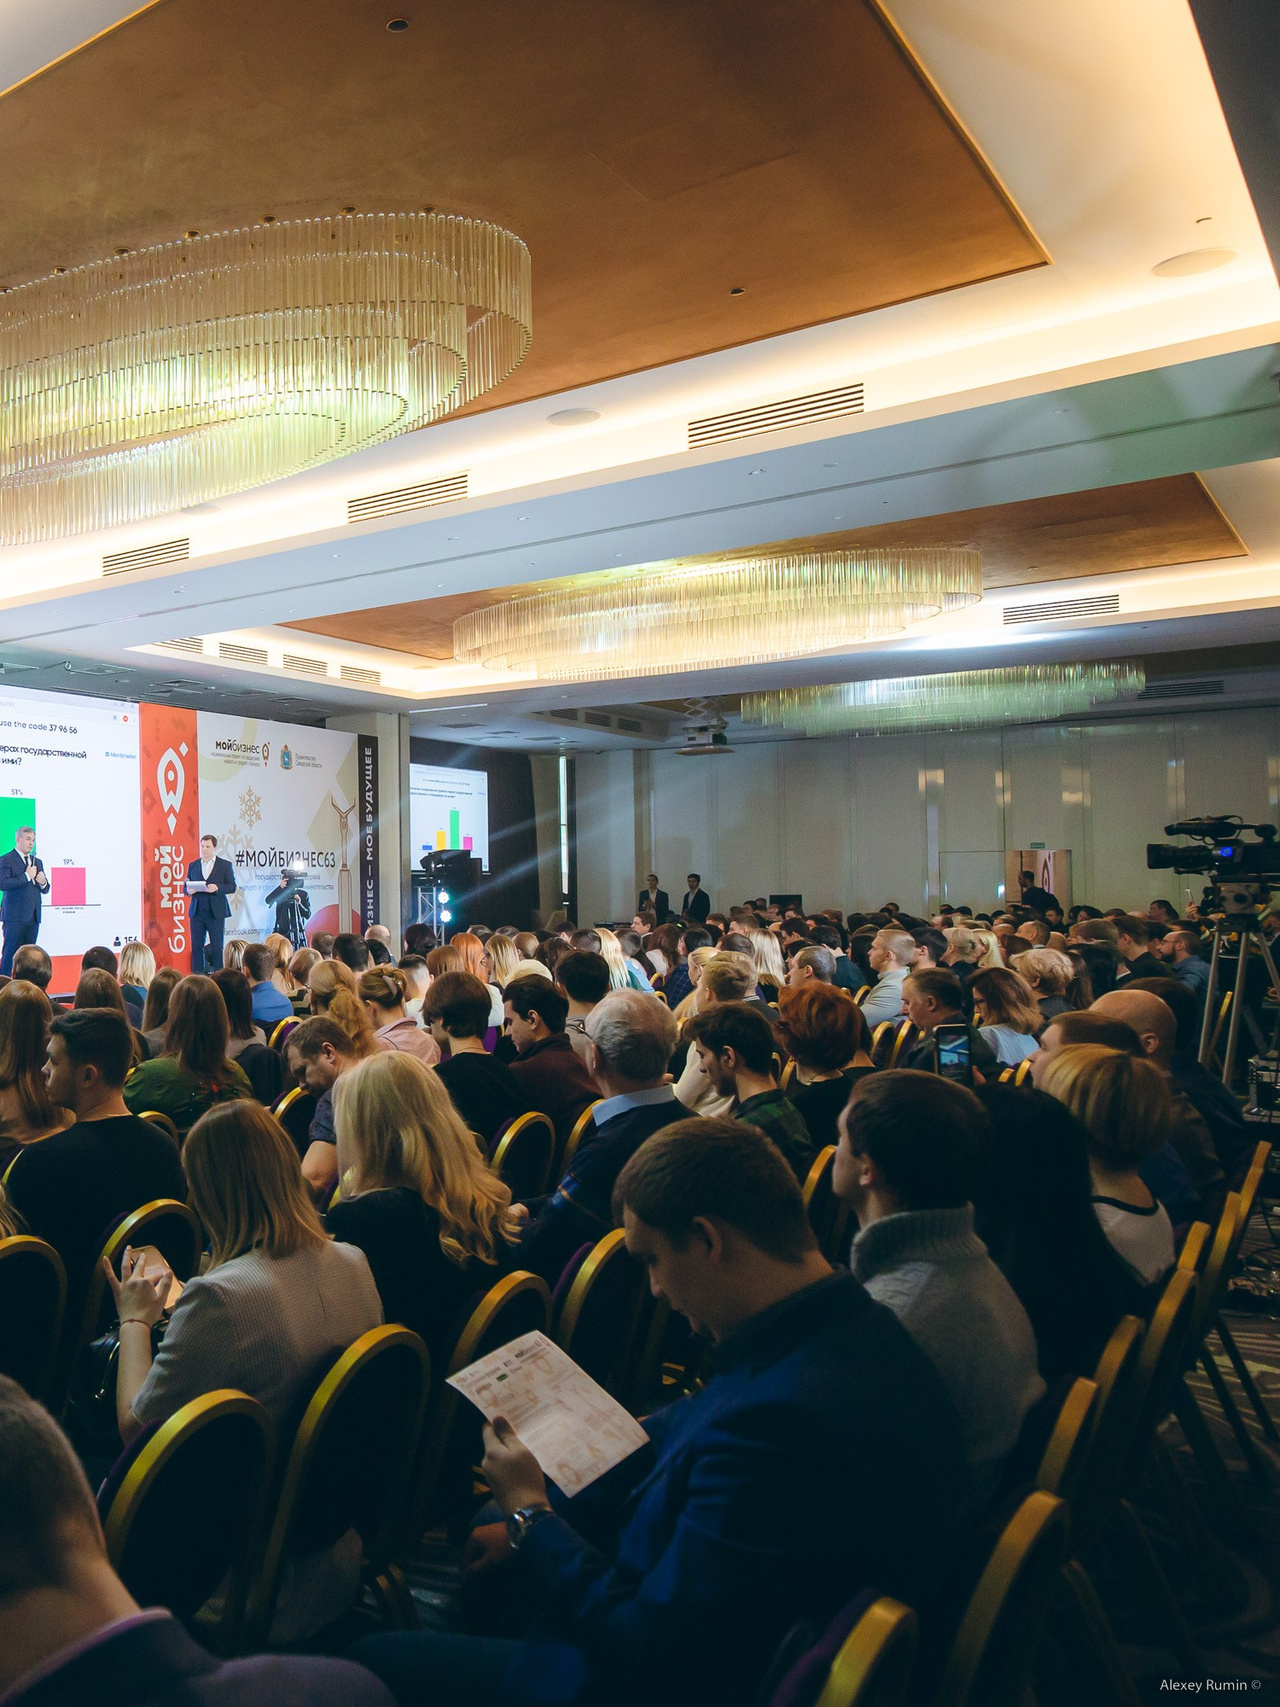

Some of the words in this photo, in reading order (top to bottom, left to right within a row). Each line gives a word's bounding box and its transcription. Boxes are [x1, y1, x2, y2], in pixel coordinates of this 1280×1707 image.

[13, 720, 27, 729] the
[28, 722, 48, 731] code
[48, 724, 57, 732] 37
[58, 725, 68, 733] 96
[69, 726, 78, 734] 56
[2, 757, 22, 766] ими?
[20, 746, 87, 760] государственной
[365, 747, 374, 822] БУДУЩЕЕ
[366, 825, 374, 861] МОЕ
[167, 845, 186, 954] бизнес
[366, 879, 374, 927] ИЗНЕС
